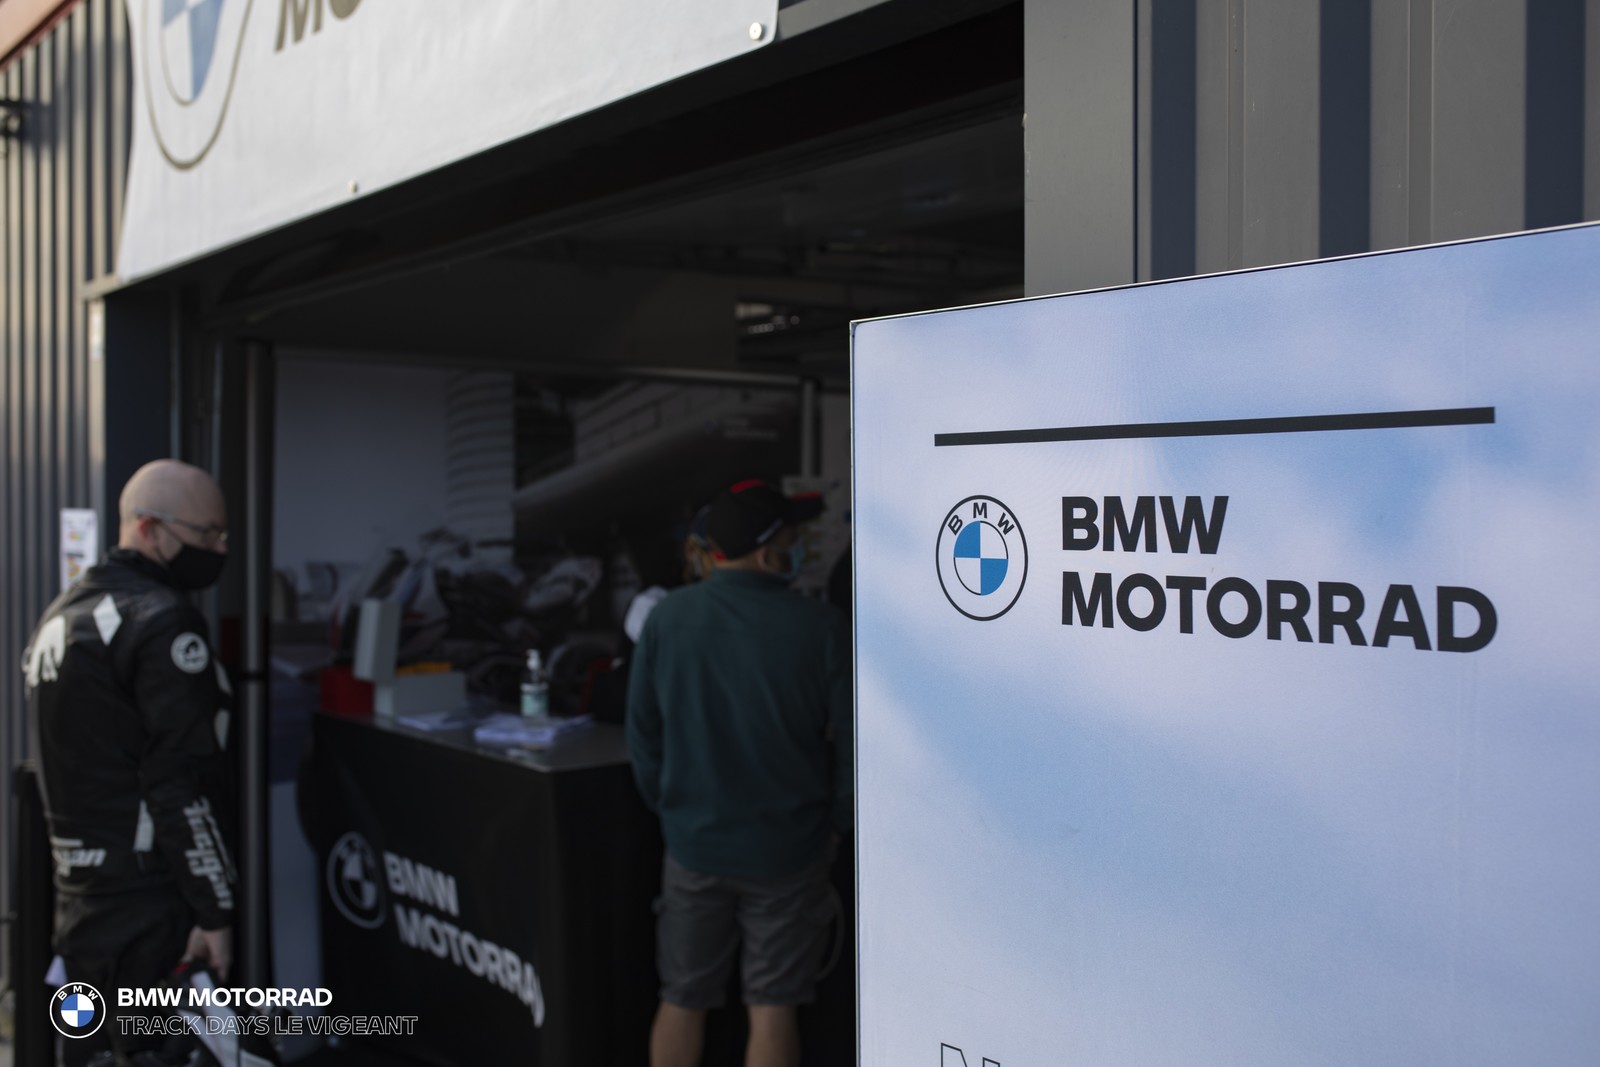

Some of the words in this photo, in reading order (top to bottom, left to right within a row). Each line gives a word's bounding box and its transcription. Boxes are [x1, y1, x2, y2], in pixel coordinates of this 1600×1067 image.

[947, 502, 1015, 536] BMW
[1062, 496, 1229, 554] BMW
[1062, 572, 1498, 653] MOTORRAD
[383, 851, 459, 916] BMW
[394, 904, 545, 1028] MOTORRA
